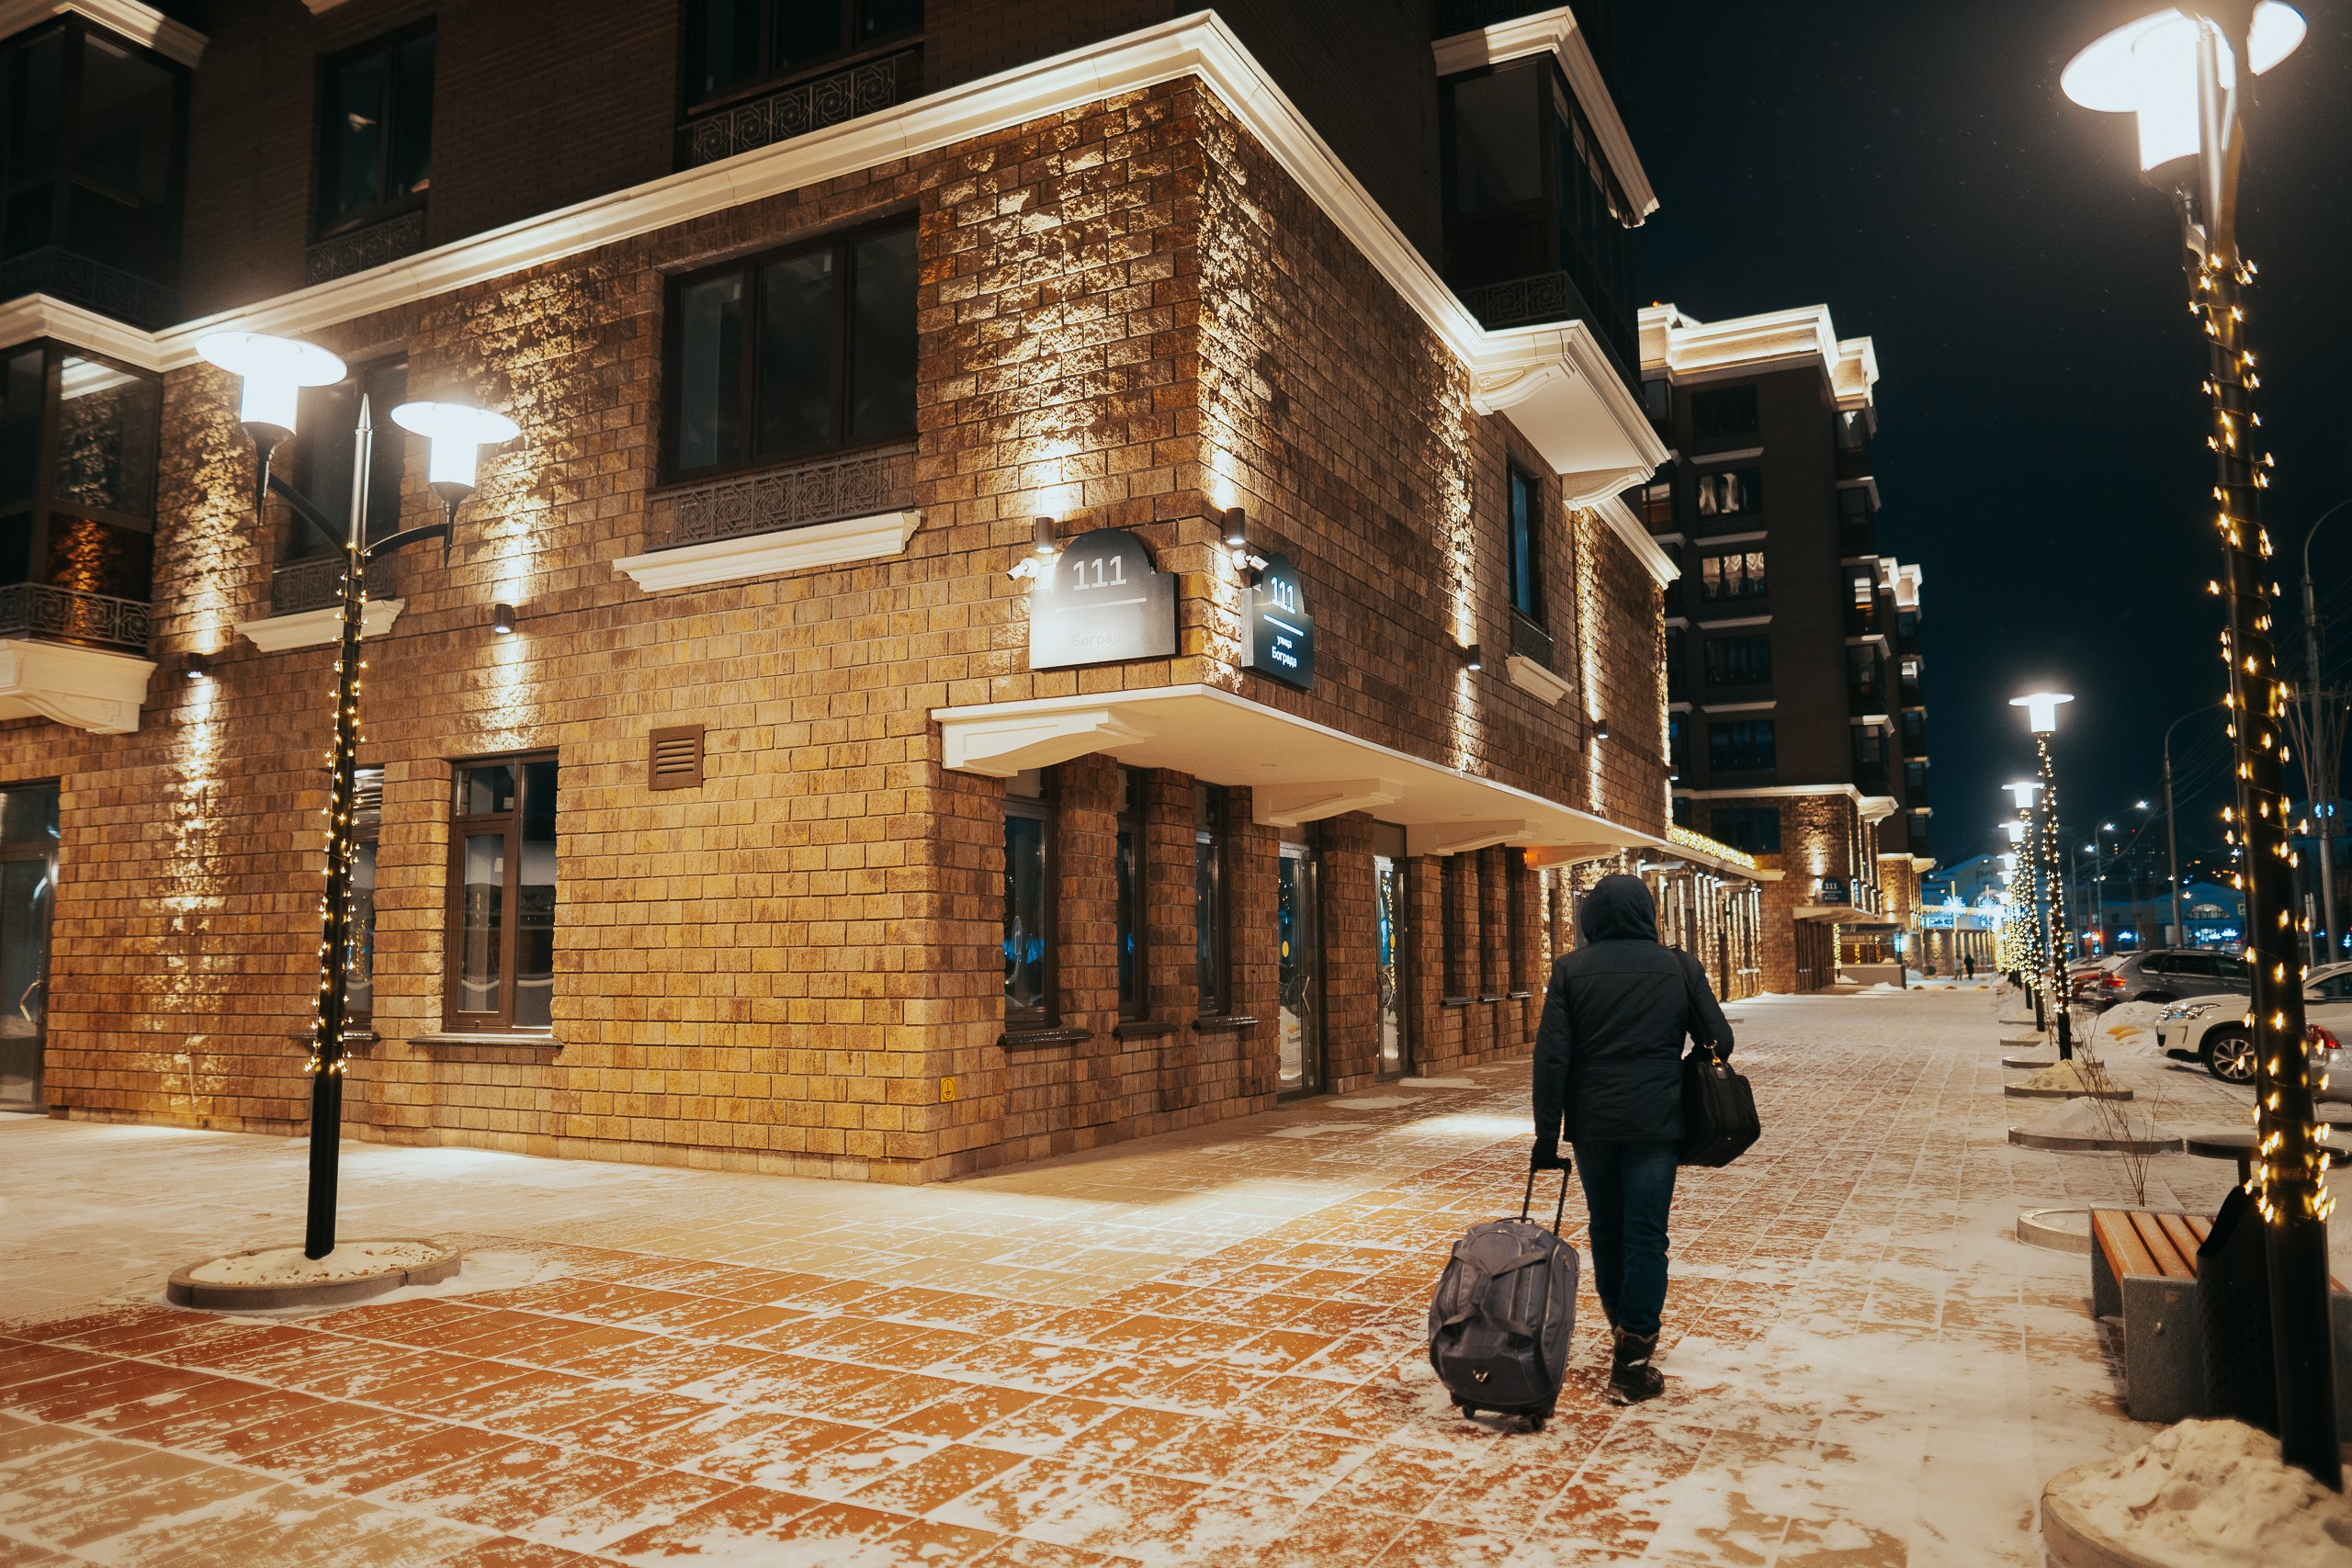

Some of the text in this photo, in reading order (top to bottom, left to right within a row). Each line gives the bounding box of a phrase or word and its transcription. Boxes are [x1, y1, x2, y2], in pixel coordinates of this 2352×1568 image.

[1072, 555, 1127, 591] 111
[1271, 576, 1296, 615] 111
[1272, 646, 1297, 668] Бограда
